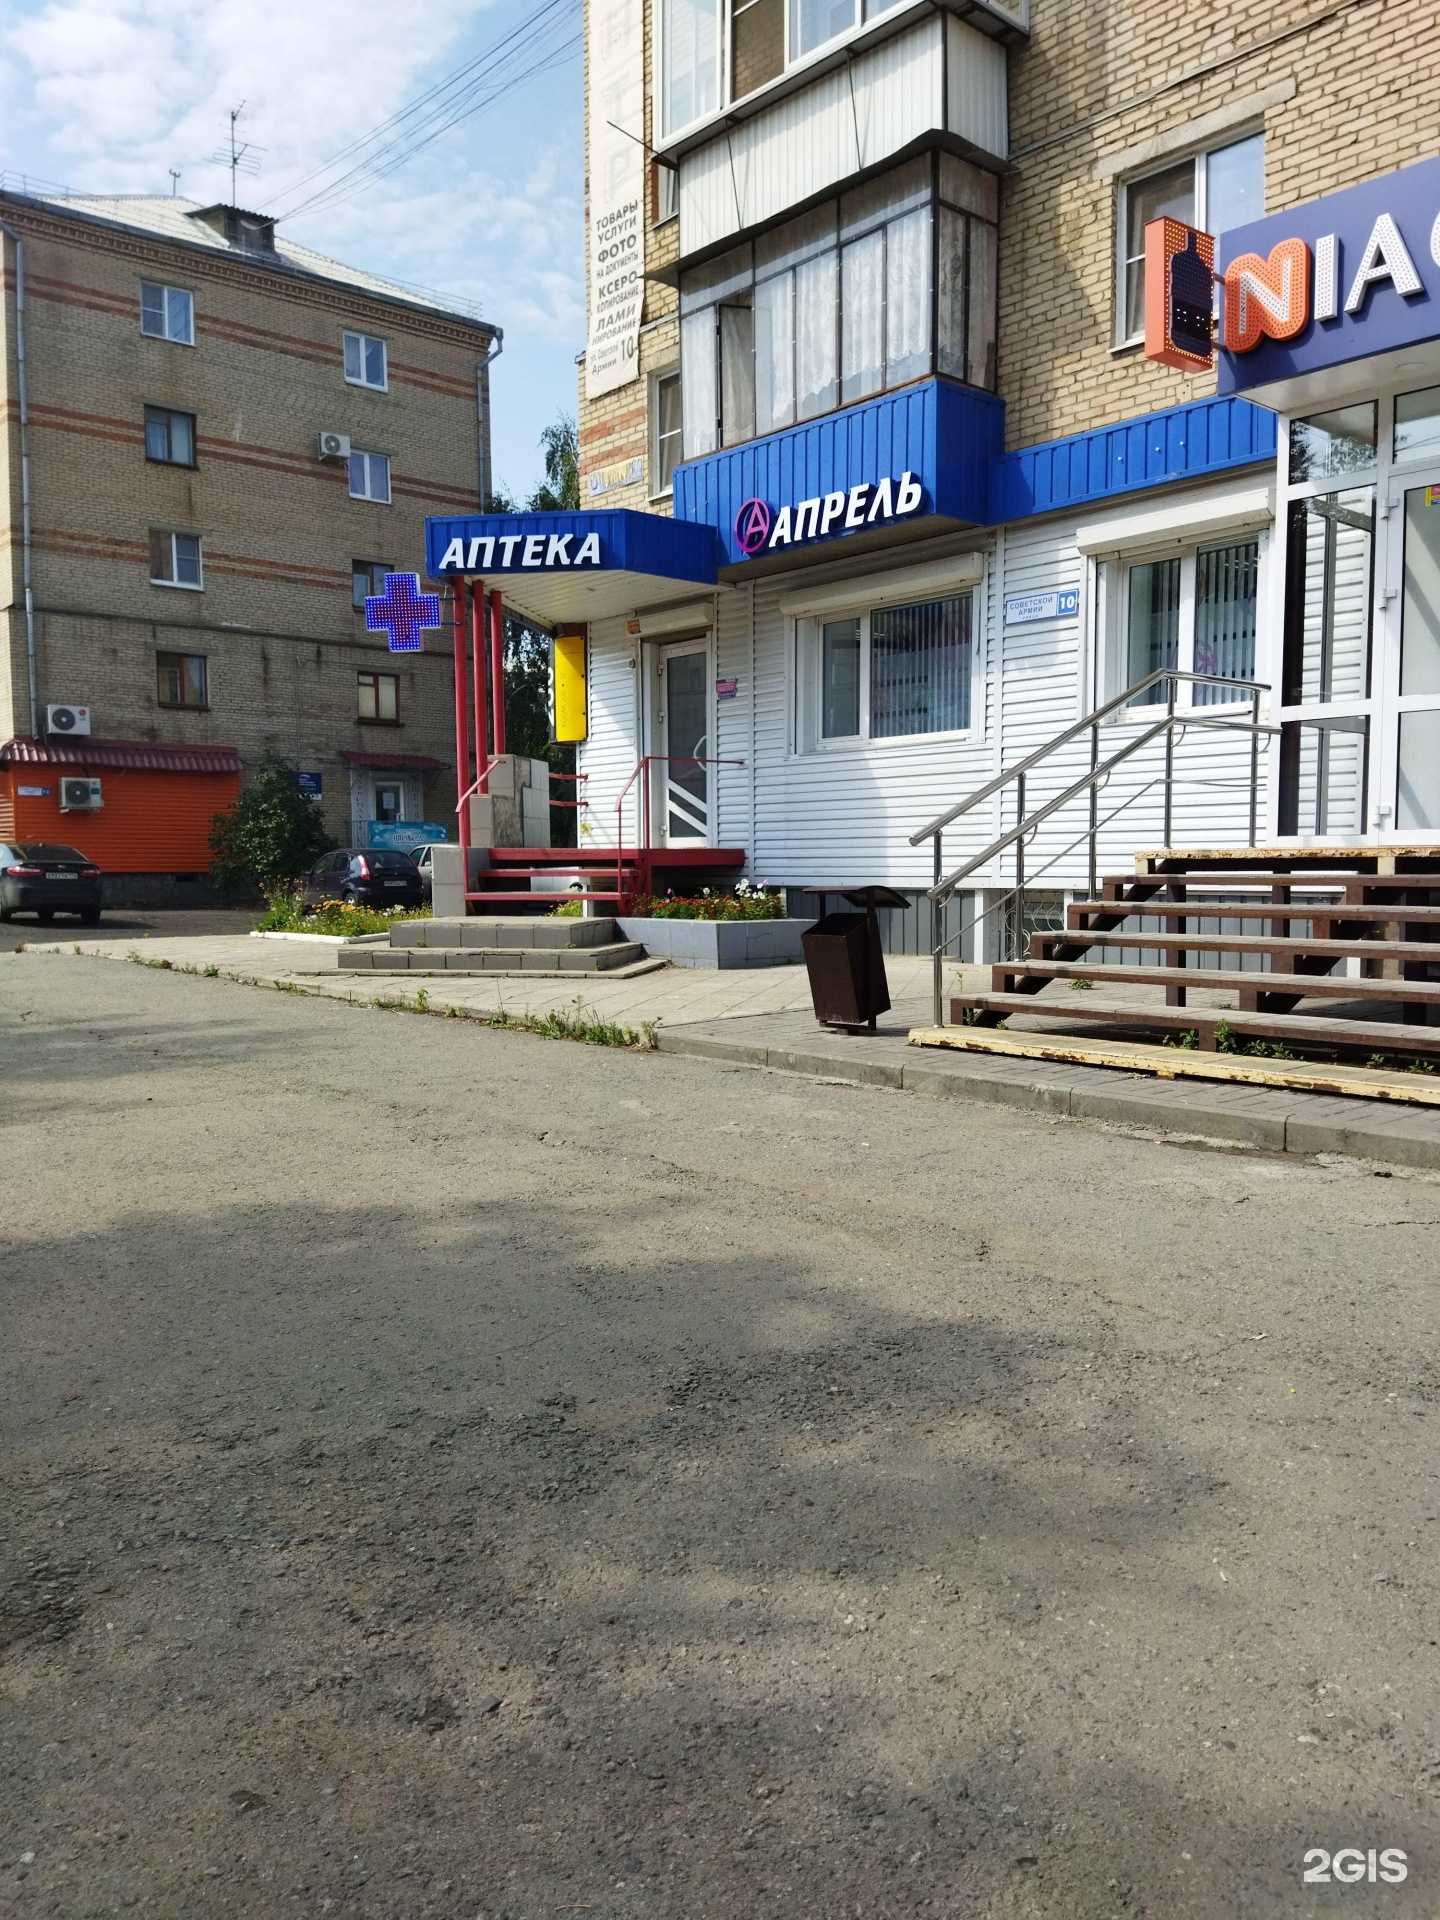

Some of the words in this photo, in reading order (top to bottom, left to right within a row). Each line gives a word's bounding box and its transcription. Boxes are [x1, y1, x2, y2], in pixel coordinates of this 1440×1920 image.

[596, 200, 638, 232] ТОВАРЫ
[598, 215, 637, 245] УСЛУГИ
[598, 234, 637, 263] ФОТО
[598, 270, 638, 299] КСЕРО
[1224, 213, 1440, 352] NIA
[596, 304, 636, 332] ЛАМИ
[621, 335, 634, 361] 10
[769, 471, 922, 548] АПРЕЛЬ
[438, 532, 600, 569] АПТЕКА
[1009, 596, 1053, 610] СОВЕТСКОЙ
[1018, 606, 1043, 616] АРМИИ
[1060, 595, 1075, 610] 10
